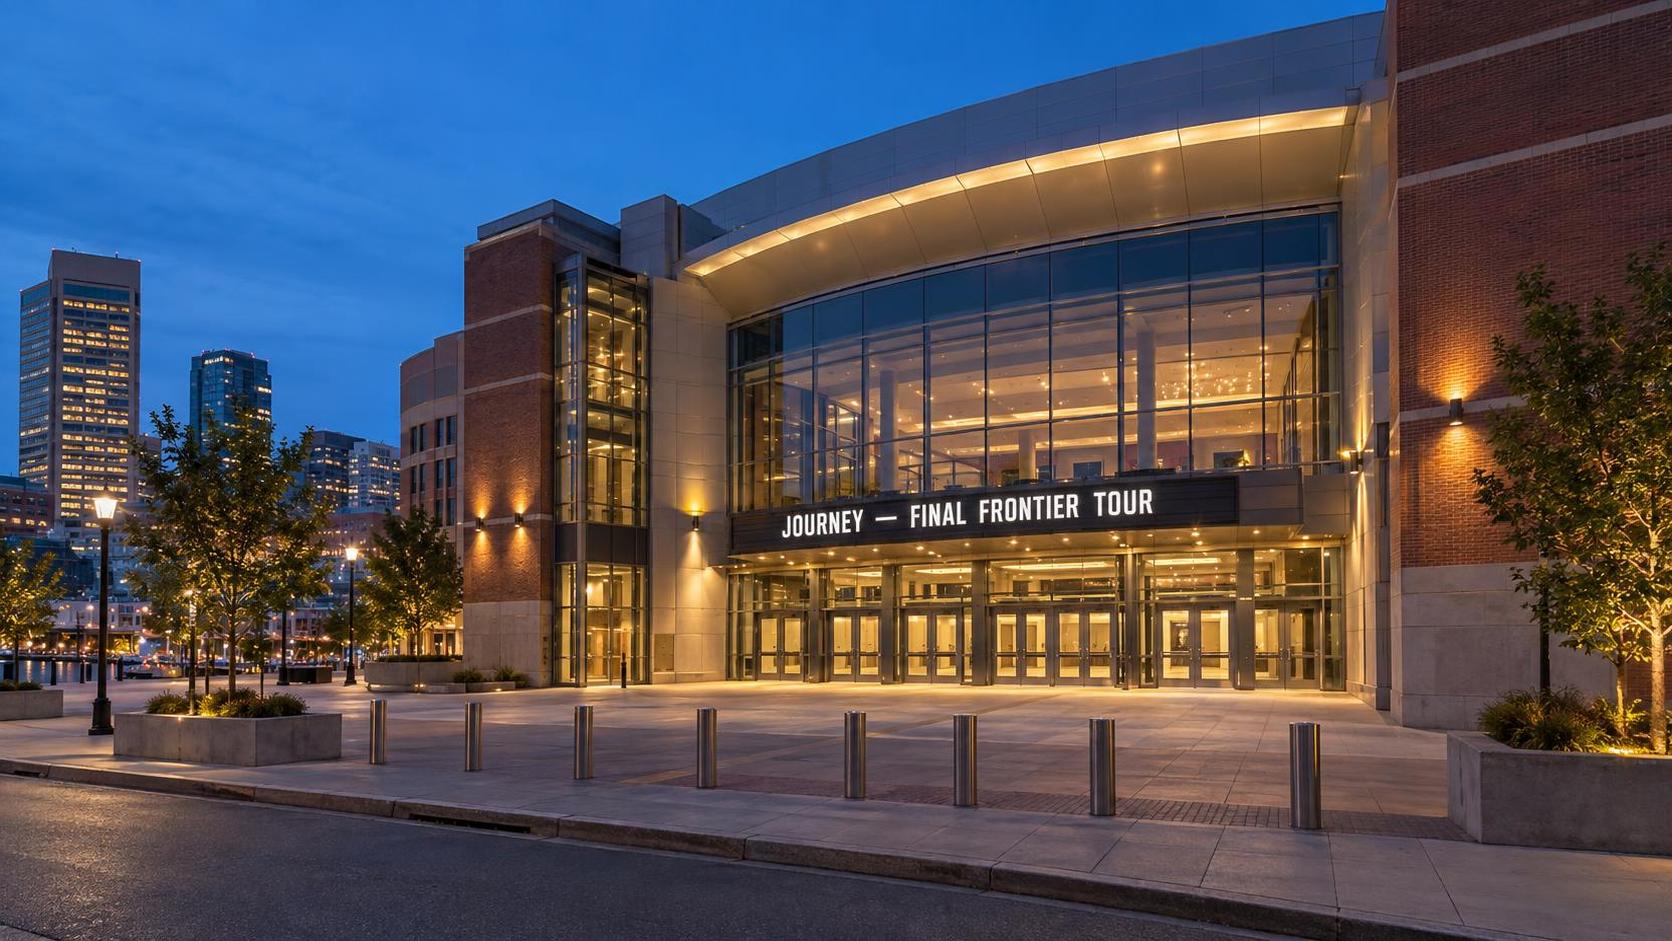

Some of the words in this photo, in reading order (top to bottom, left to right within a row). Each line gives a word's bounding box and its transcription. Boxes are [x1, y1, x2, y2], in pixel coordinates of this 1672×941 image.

[782, 509, 864, 538] JOURNEY
[910, 501, 967, 528] FINAL
[979, 493, 1079, 524] FRONTIER
[1093, 488, 1153, 517] TOUR
